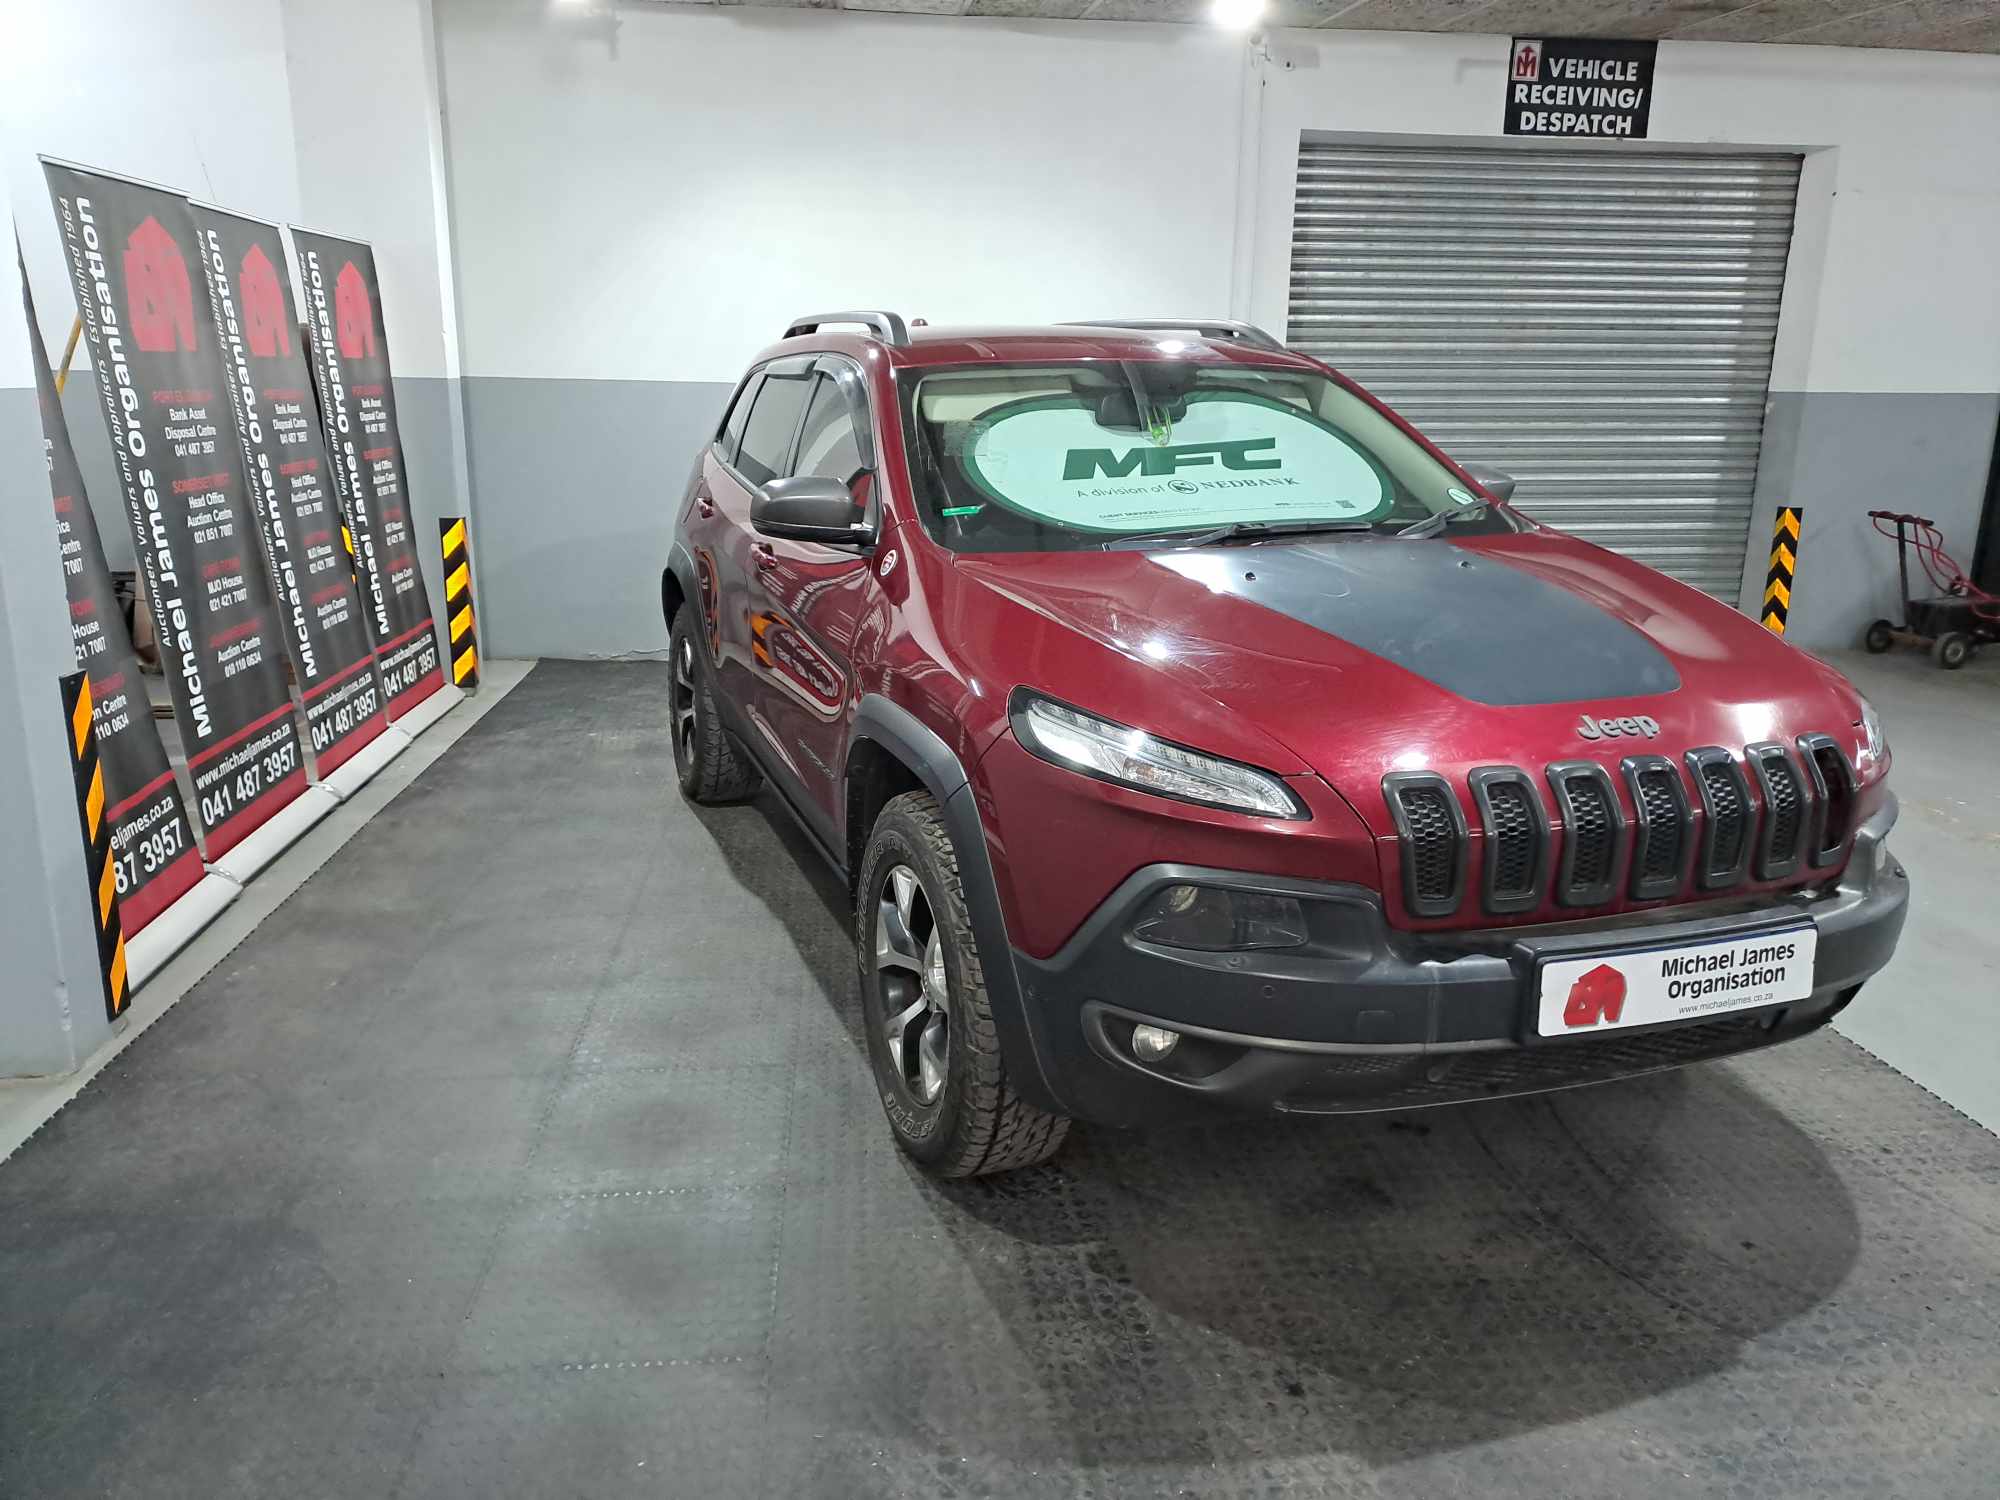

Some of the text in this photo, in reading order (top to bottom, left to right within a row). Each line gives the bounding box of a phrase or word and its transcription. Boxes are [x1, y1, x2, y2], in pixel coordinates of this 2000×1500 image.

[1548, 57, 1640, 81] VEHICLE
[1514, 83, 1643, 109] RECEIVING/
[1520, 111, 1632, 135] DESPATCH
[59, 196, 78, 240] 1964
[69, 244, 100, 343] Established
[207, 229, 262, 444] Organisation
[97, 358, 125, 446] Appraisers
[169, 408, 188, 421] Bank
[226, 362, 247, 436] Appraisers
[165, 425, 197, 441] Disposal
[175, 444, 187, 457] 041
[241, 438, 254, 464] and
[308, 251, 390, 635] Michael James Organisation
[328, 428, 339, 452] and
[76, 197, 212, 738] Michael James Organisation
[116, 449, 133, 482] and
[335, 454, 349, 496] Valuers
[1062, 437, 1282, 481] MFC
[250, 468, 265, 517] Valuers
[257, 453, 288, 553] James
[1076, 477, 1299, 498] A division of NEDBANK
[128, 486, 147, 545] Valuers
[145, 552, 172, 647] Auctioneers,
[280, 561, 317, 678] Michael
[72, 621, 100, 640] House
[76, 643, 88, 660] 21
[383, 647, 436, 697] 041 487 3957
[102, 694, 127, 714] Centre
[312, 688, 377, 750] 041 487 3957
[1577, 713, 1660, 740] Jeep
[195, 723, 291, 790] www.michaeljames.co.za
[202, 741, 295, 826] 041 487 3957
[110, 796, 174, 850] eljames.co.za
[113, 817, 183, 894] 87 3957
[1661, 943, 1795, 978] Michael James
[1668, 966, 1785, 999] Organisation
[1678, 992, 1774, 1015] www.michaeljames.co.za
